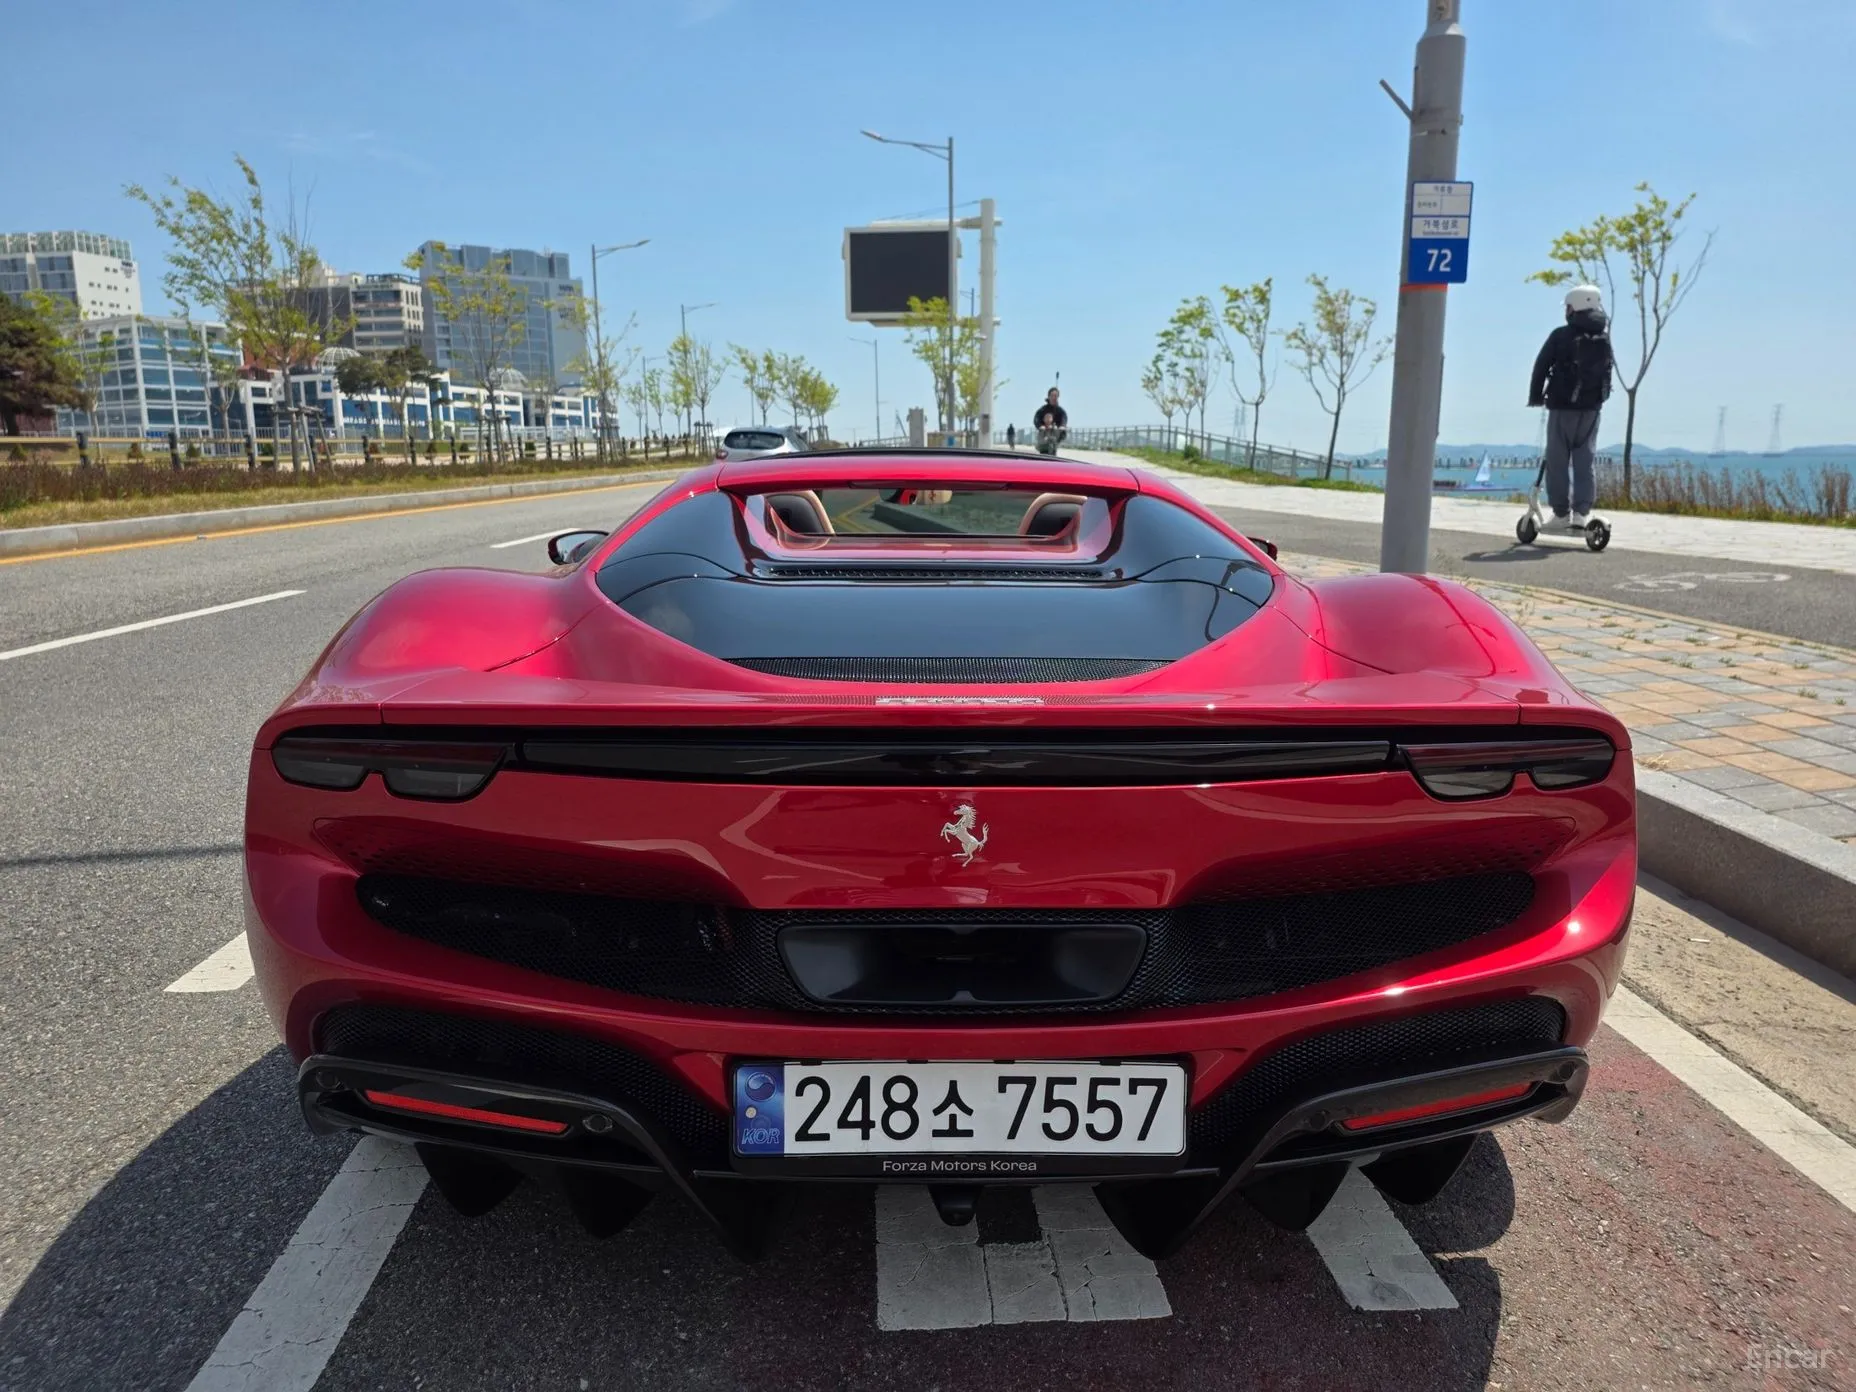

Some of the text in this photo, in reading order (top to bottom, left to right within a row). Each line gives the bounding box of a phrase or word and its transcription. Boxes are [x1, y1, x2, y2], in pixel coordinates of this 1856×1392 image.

[1427, 248, 1452, 272] 72
[794, 1074, 1168, 1142] 248소 7557
[741, 1128, 780, 1145] KOR
[883, 1160, 1037, 1172] Forza Motors Korea
